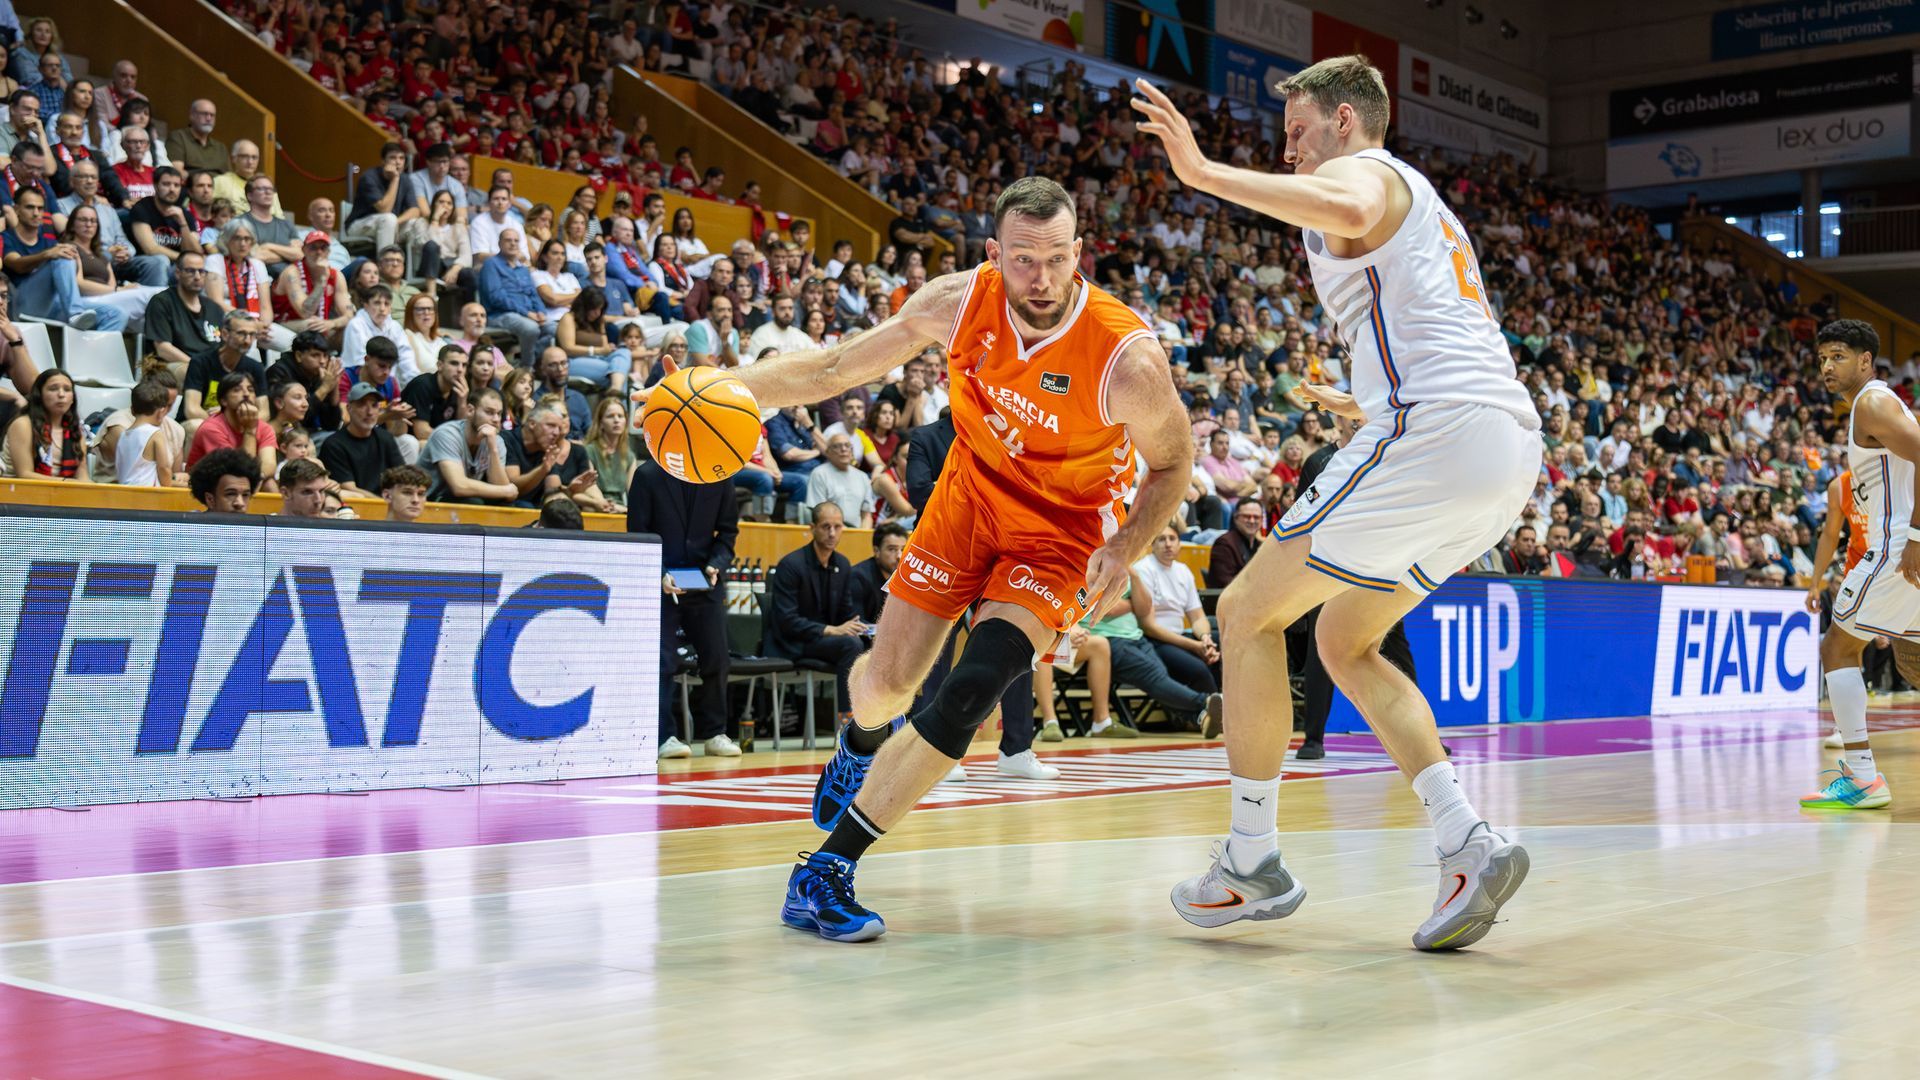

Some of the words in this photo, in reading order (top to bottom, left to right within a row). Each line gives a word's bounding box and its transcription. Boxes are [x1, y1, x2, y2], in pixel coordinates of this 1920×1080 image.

[1438, 74, 1473, 106] Diari
[1477, 88, 1494, 113] de
[1496, 96, 1540, 129] Girona
[1661, 90, 1760, 117] Grabalosa
[1776, 125, 1817, 148] lex
[1825, 117, 1885, 143] duo
[983, 407, 1026, 459] 24
[904, 551, 950, 586] PULEVA
[1018, 575, 1063, 610] Midea
[0, 561, 611, 758] FIATC
[1672, 609, 1810, 697] FIATC
